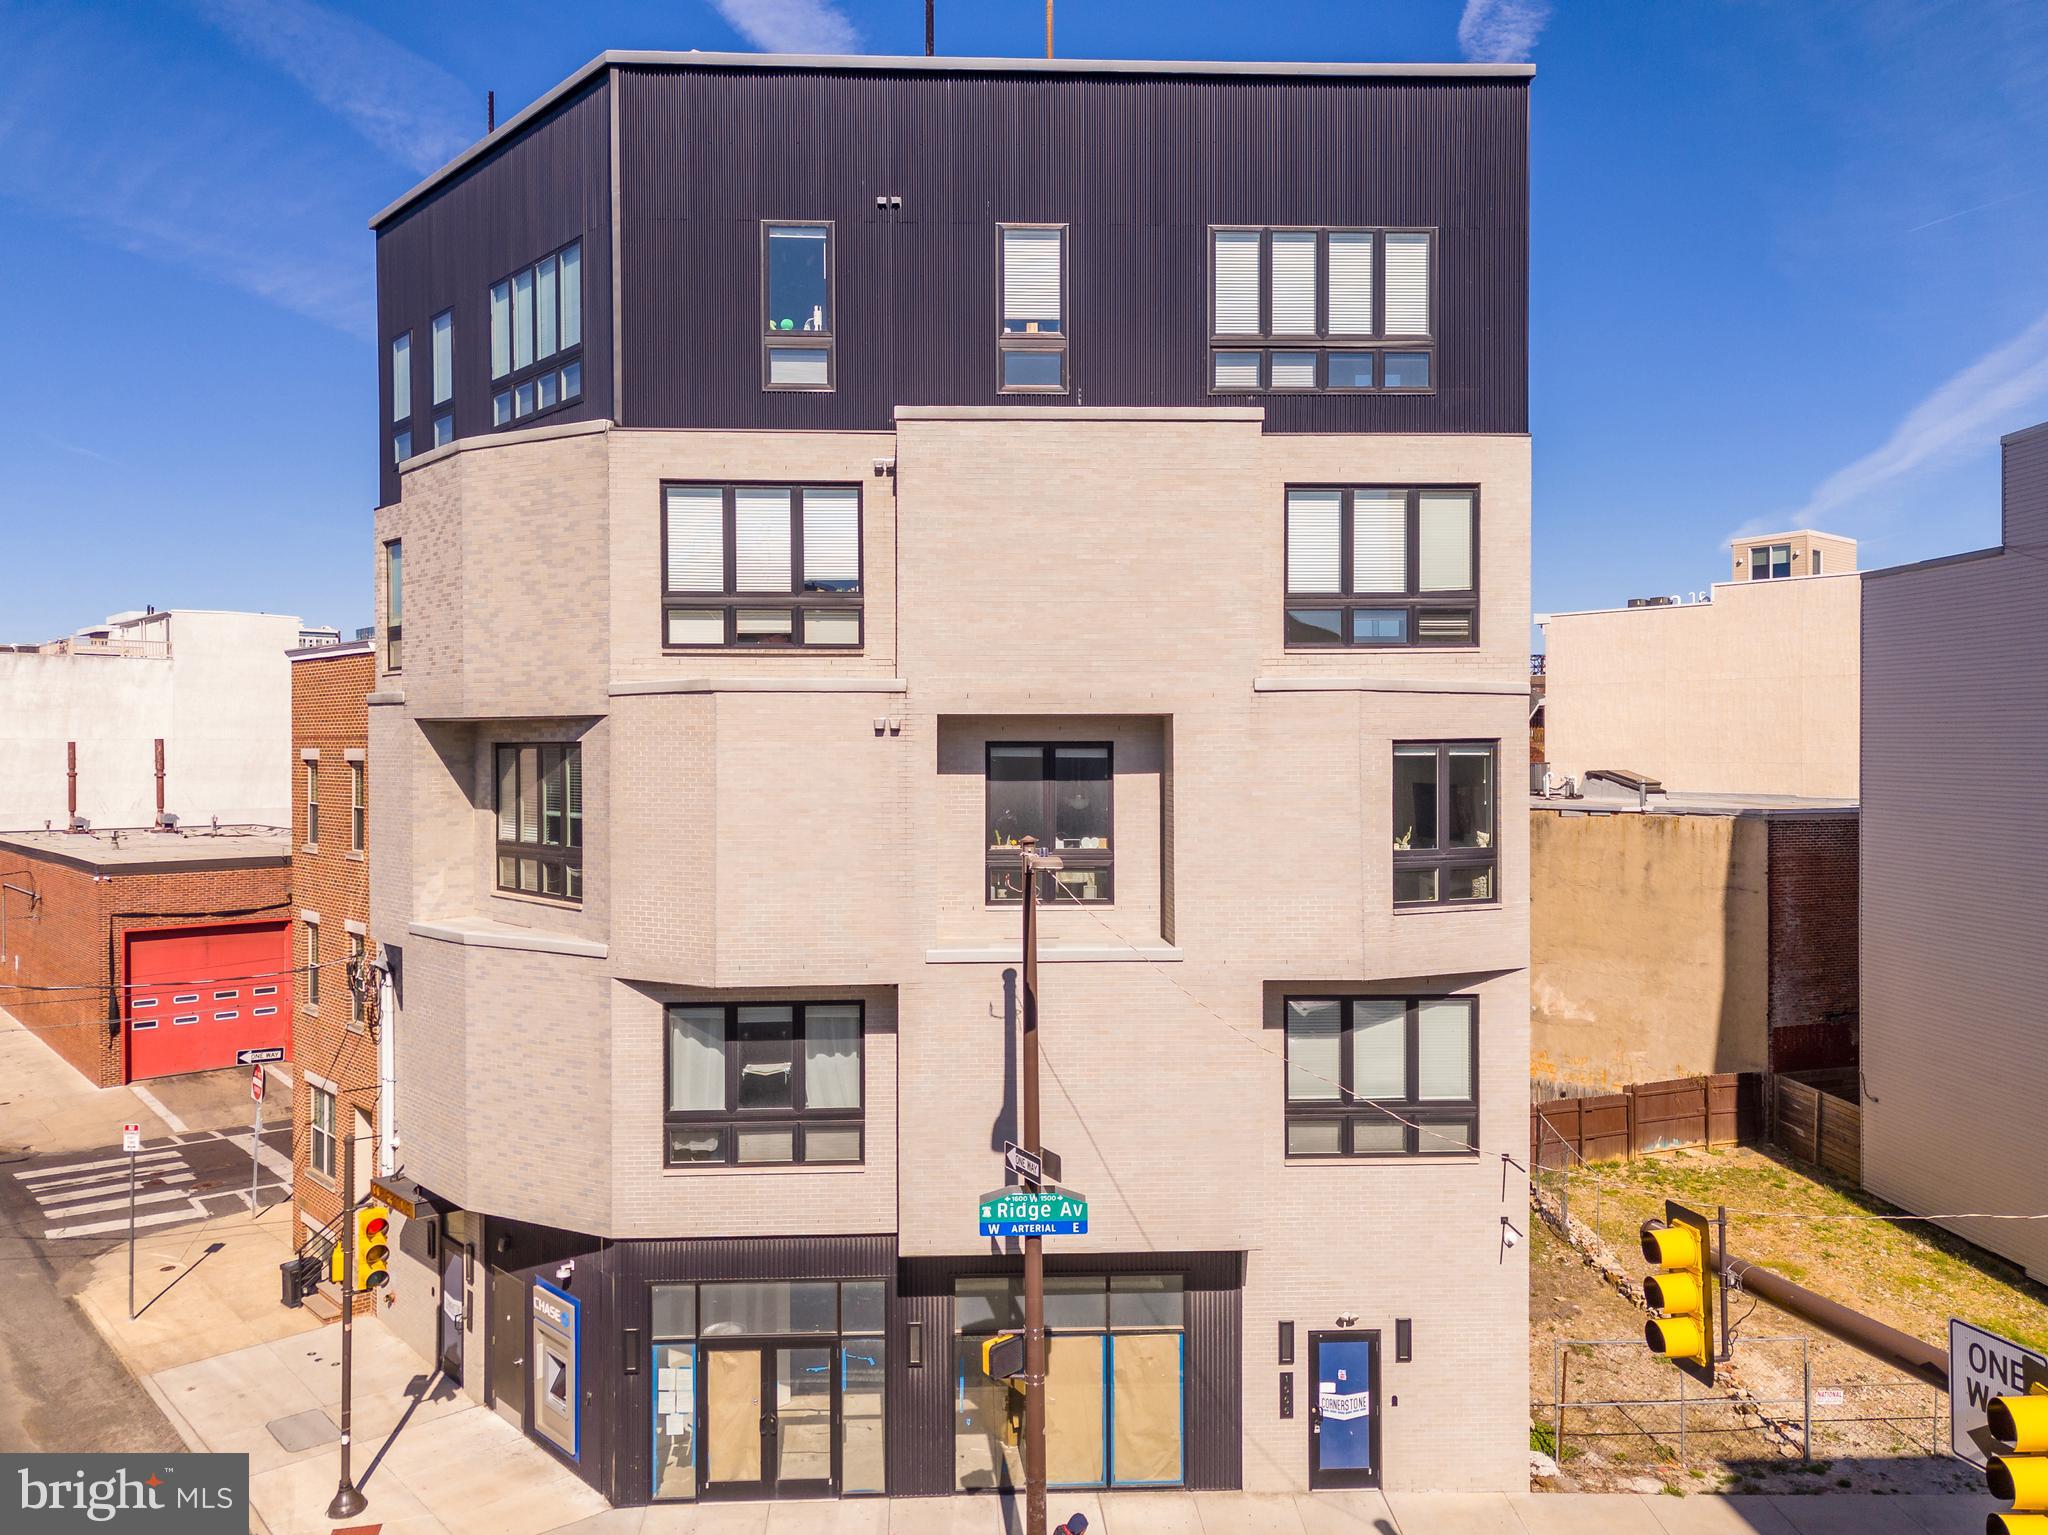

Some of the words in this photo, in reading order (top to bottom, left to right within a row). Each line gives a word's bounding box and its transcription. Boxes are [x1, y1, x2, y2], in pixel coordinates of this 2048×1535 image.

[1015, 1154, 1026, 1168] ONE
[1026, 1160, 1038, 1173] WAY
[997, 1202, 1051, 1220] Ridge
[1060, 1201, 1083, 1217] Av
[988, 1224, 1000, 1234] W
[1011, 1224, 1056, 1233] ARTERIAL
[1072, 1222, 1080, 1233] E
[533, 1296, 561, 1323] CHASE
[1968, 1342, 2024, 1393] ONE
[1321, 1396, 1367, 1411] CORNERSTONE
